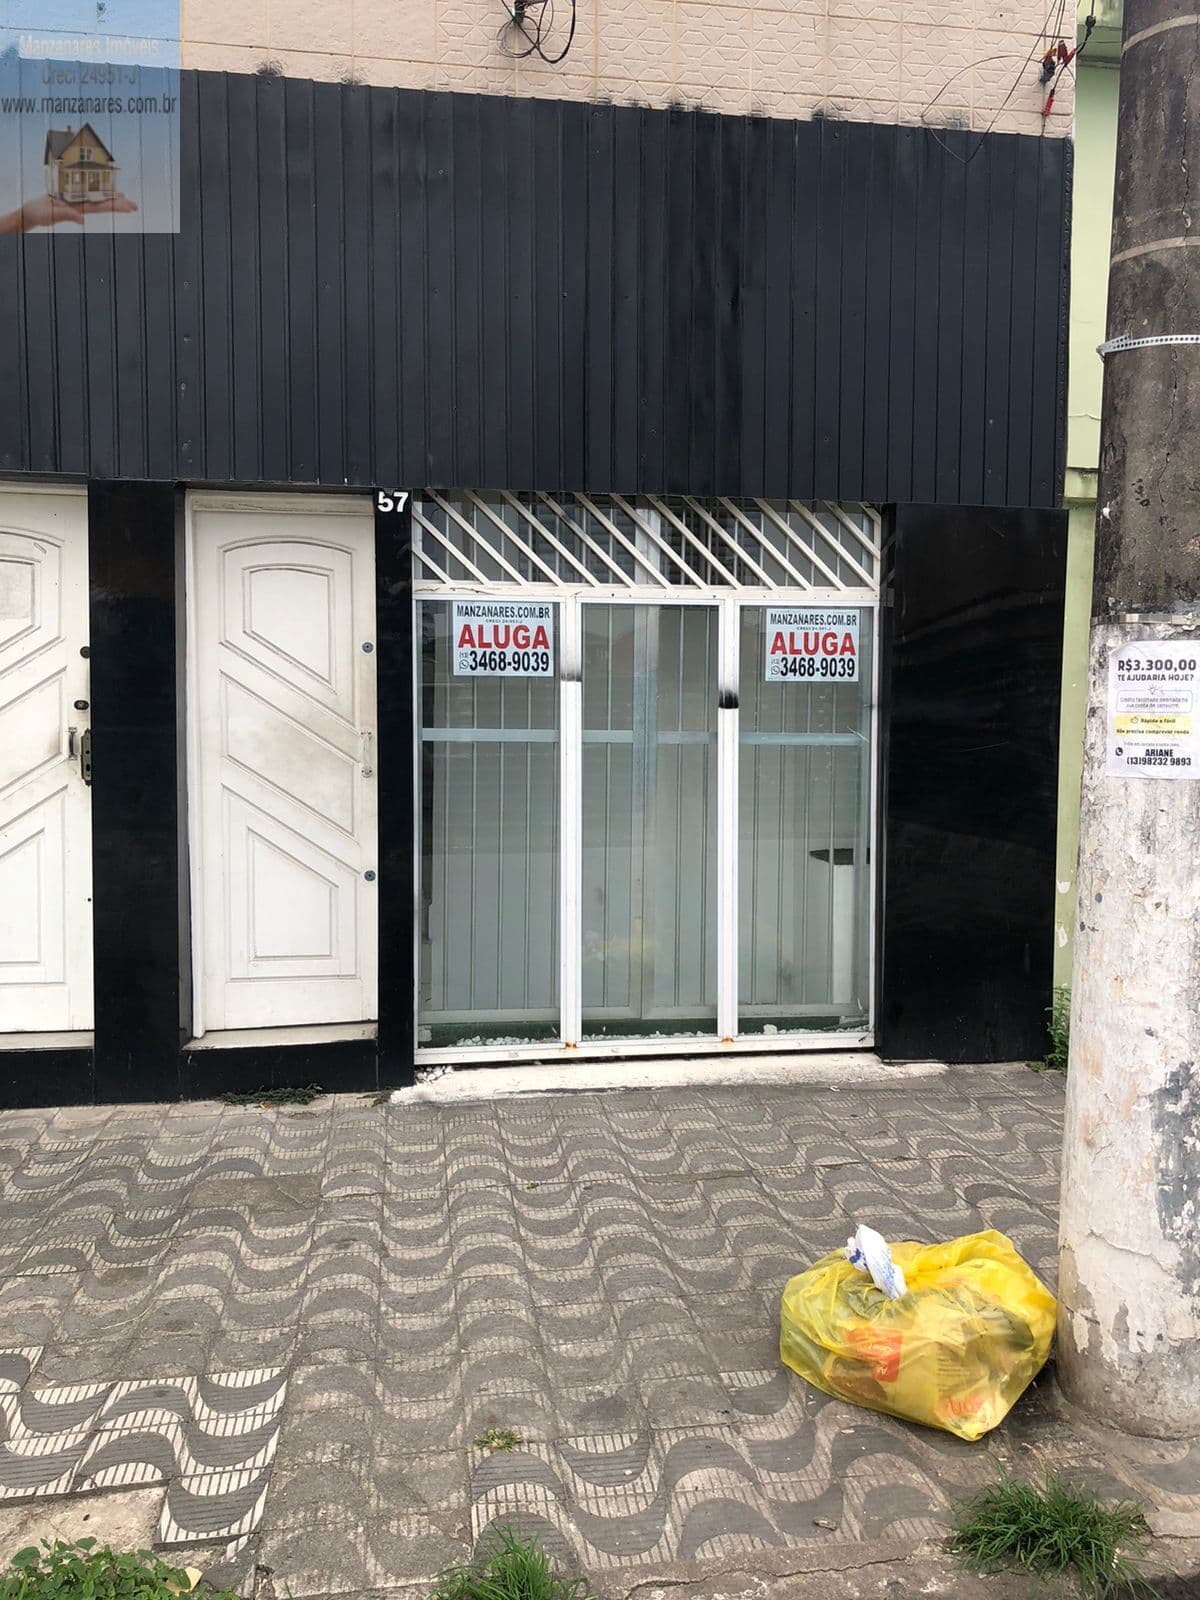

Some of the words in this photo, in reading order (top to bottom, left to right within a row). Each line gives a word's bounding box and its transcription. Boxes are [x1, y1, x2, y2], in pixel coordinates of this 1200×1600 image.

[377, 491, 409, 512] 57
[457, 605, 550, 619] MANZANARES.COM.BR
[770, 613, 857, 626] MANZANARES.COM.BR
[458, 624, 550, 649] ALUGA
[770, 631, 856, 656] ALUGA
[469, 650, 549, 671] 3468-9039
[780, 656, 855, 677] 3468-9039
[1117, 658, 1196, 673] R$3.300,00
[1127, 757, 1168, 766] (13)98232
[1170, 757, 1191, 766] 9893
[1145, 748, 1173, 757] ARIANE
